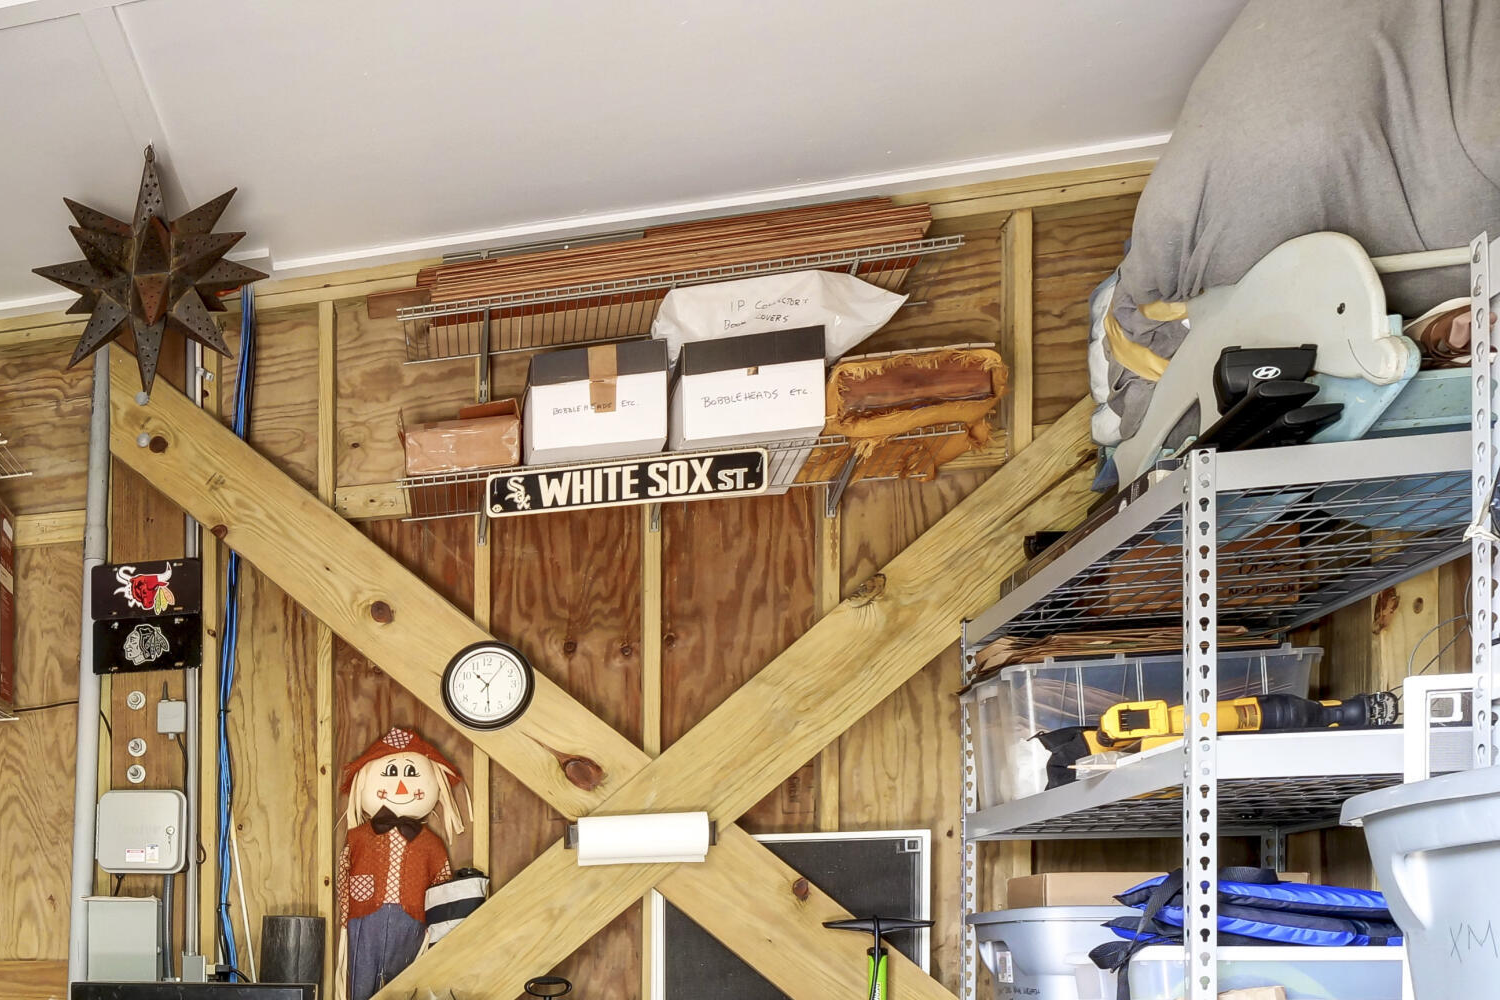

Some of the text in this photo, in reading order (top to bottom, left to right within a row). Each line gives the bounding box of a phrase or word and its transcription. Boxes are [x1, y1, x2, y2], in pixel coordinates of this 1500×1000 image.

[538, 466, 641, 507] WHITE
[647, 457, 715, 496] SOX
[717, 468, 756, 491] ST.
[463, 671, 472, 681] 10
